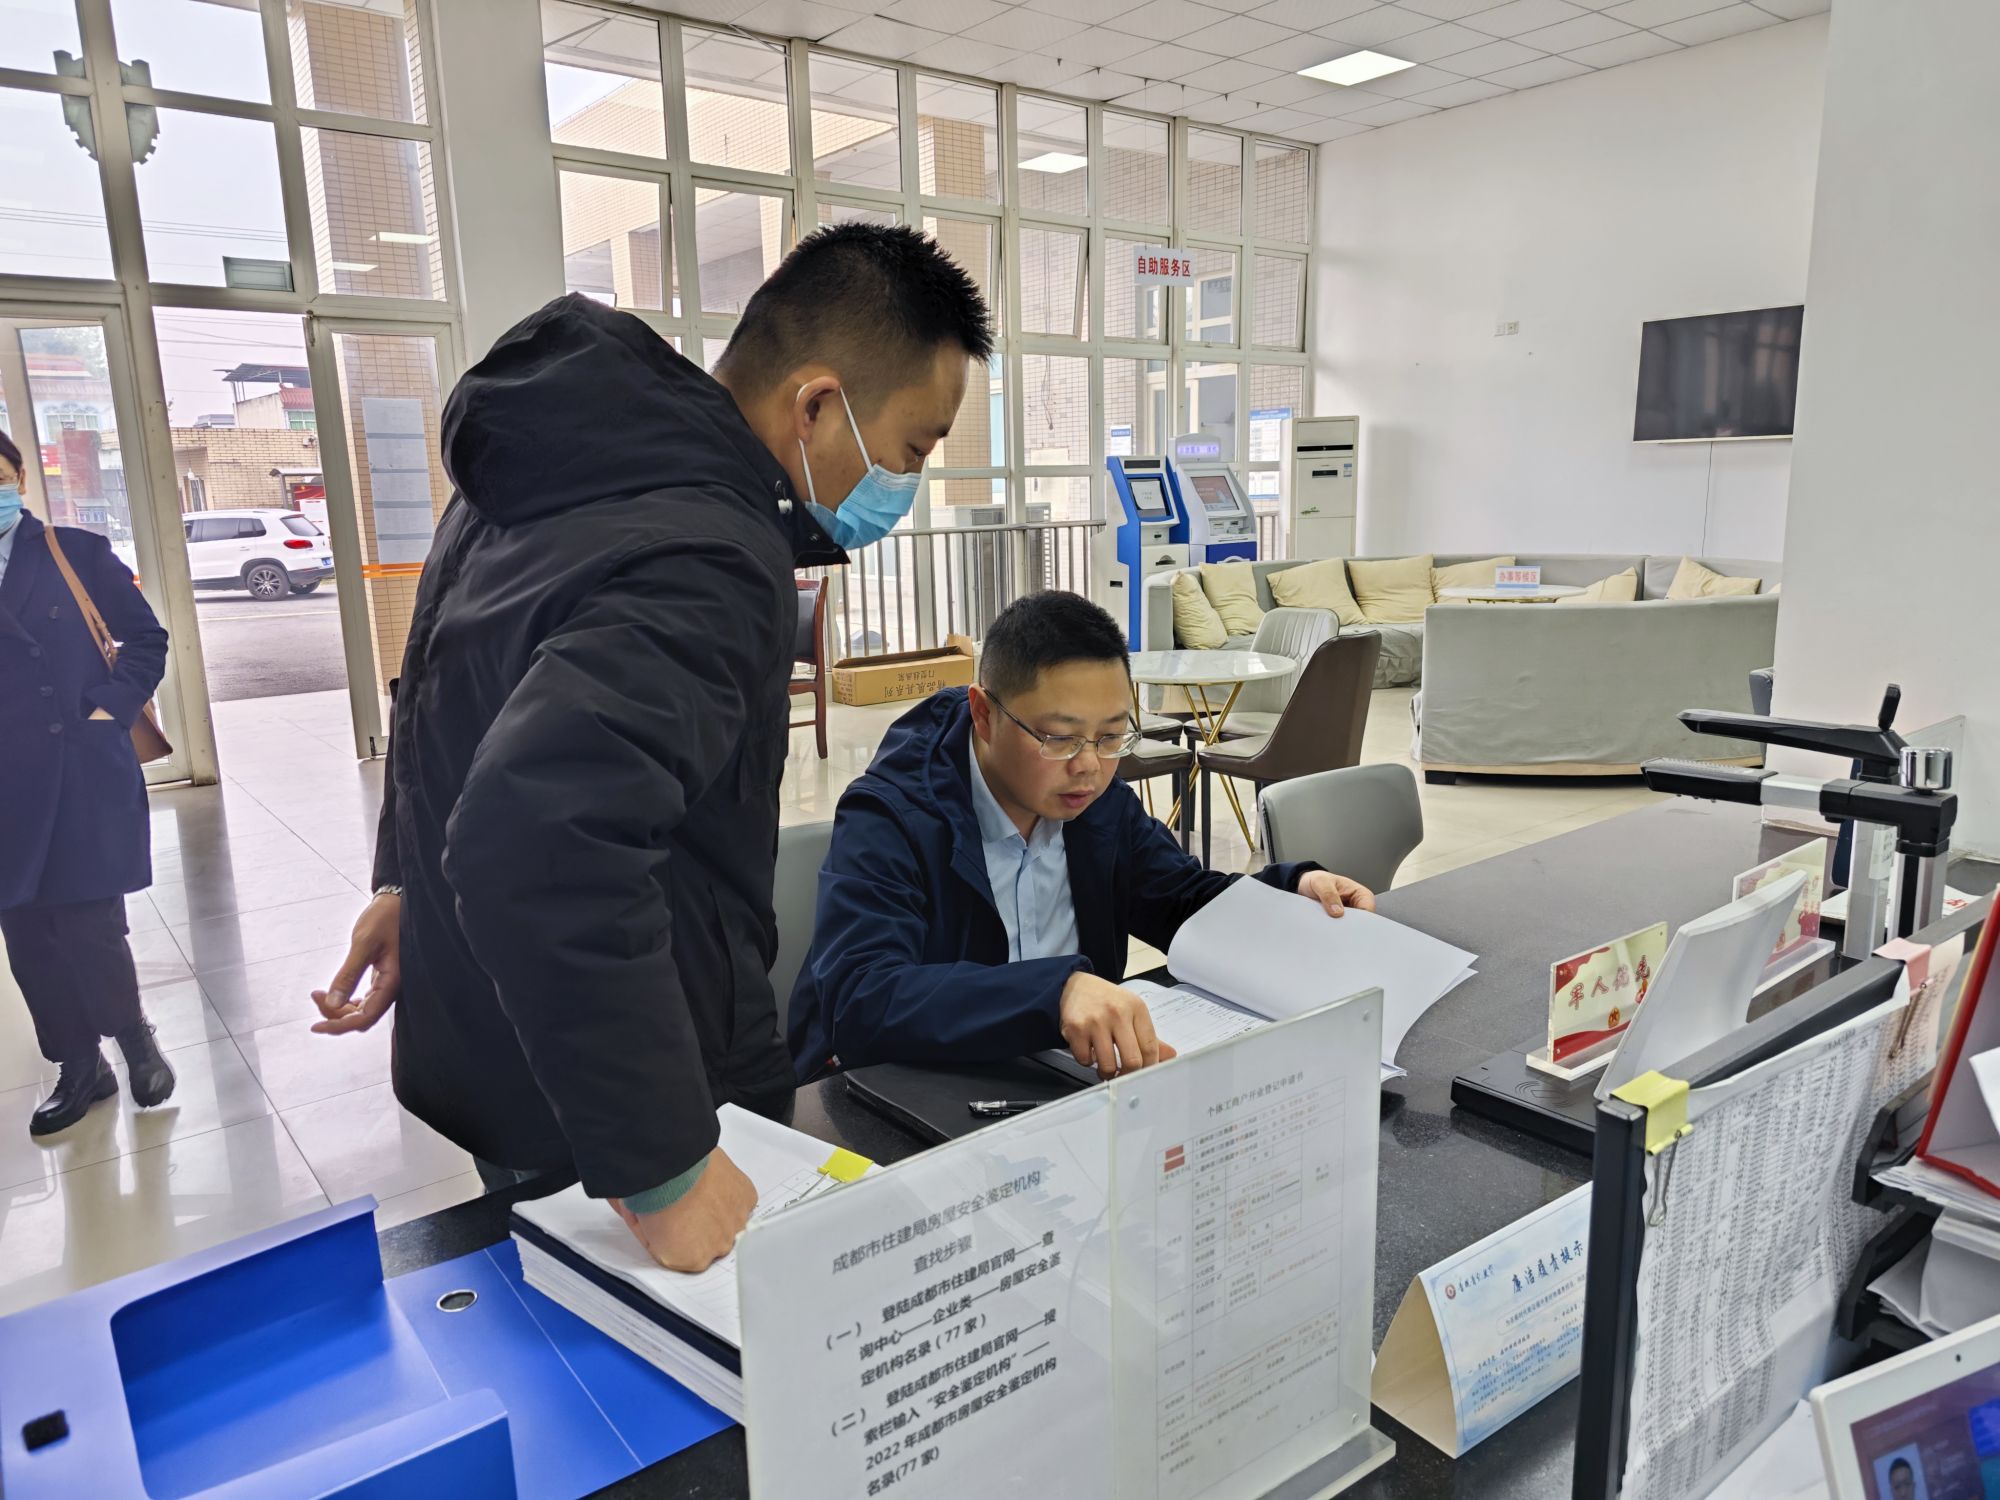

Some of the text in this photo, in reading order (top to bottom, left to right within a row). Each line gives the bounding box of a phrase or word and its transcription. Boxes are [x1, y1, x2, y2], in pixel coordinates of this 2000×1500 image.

[1138, 256, 1191, 277] 自助服务区
[1568, 955, 1651, 1011] 军人优先
[832, 1170, 1041, 1275] 成都市住建局房屋安全鉴定机构
[913, 1233, 973, 1275] 查找步骤
[1512, 1240, 1584, 1294] 廉洁履责提示
